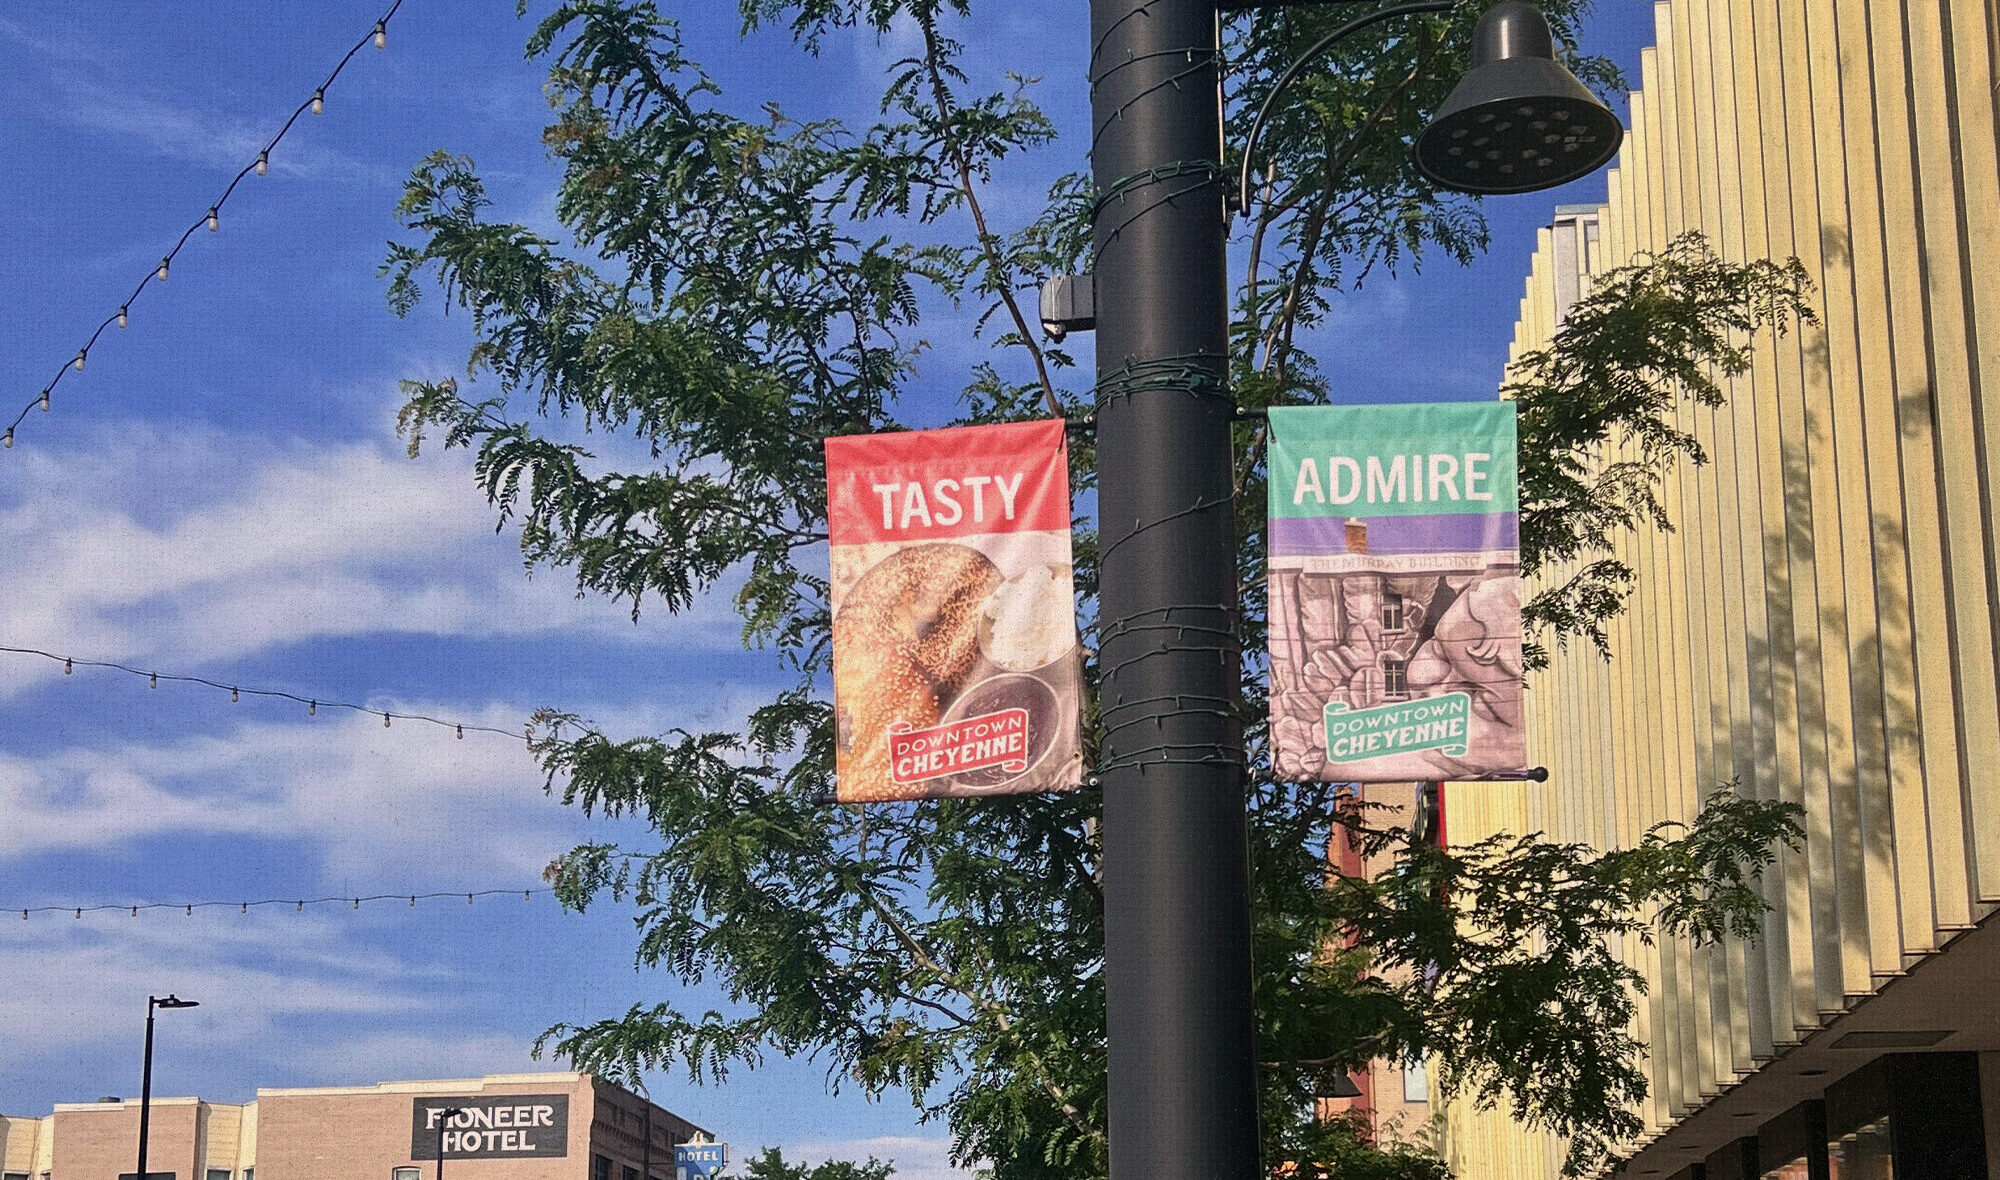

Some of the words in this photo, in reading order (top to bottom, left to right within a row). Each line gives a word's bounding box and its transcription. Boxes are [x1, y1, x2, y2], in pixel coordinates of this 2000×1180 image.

[1293, 453, 1493, 505] ADMIRE
[872, 473, 1023, 530] TASTY
[1409, 555, 1481, 568] BUILDING
[897, 716, 1022, 756] DOWNTOWN
[1333, 700, 1464, 736] DOWNTOWN
[1333, 717, 1464, 757] CHEYENNE
[897, 732, 1022, 777] CHEYENNE
[442, 1130, 536, 1153] HOTEL
[678, 1150, 718, 1162] HOTEL
